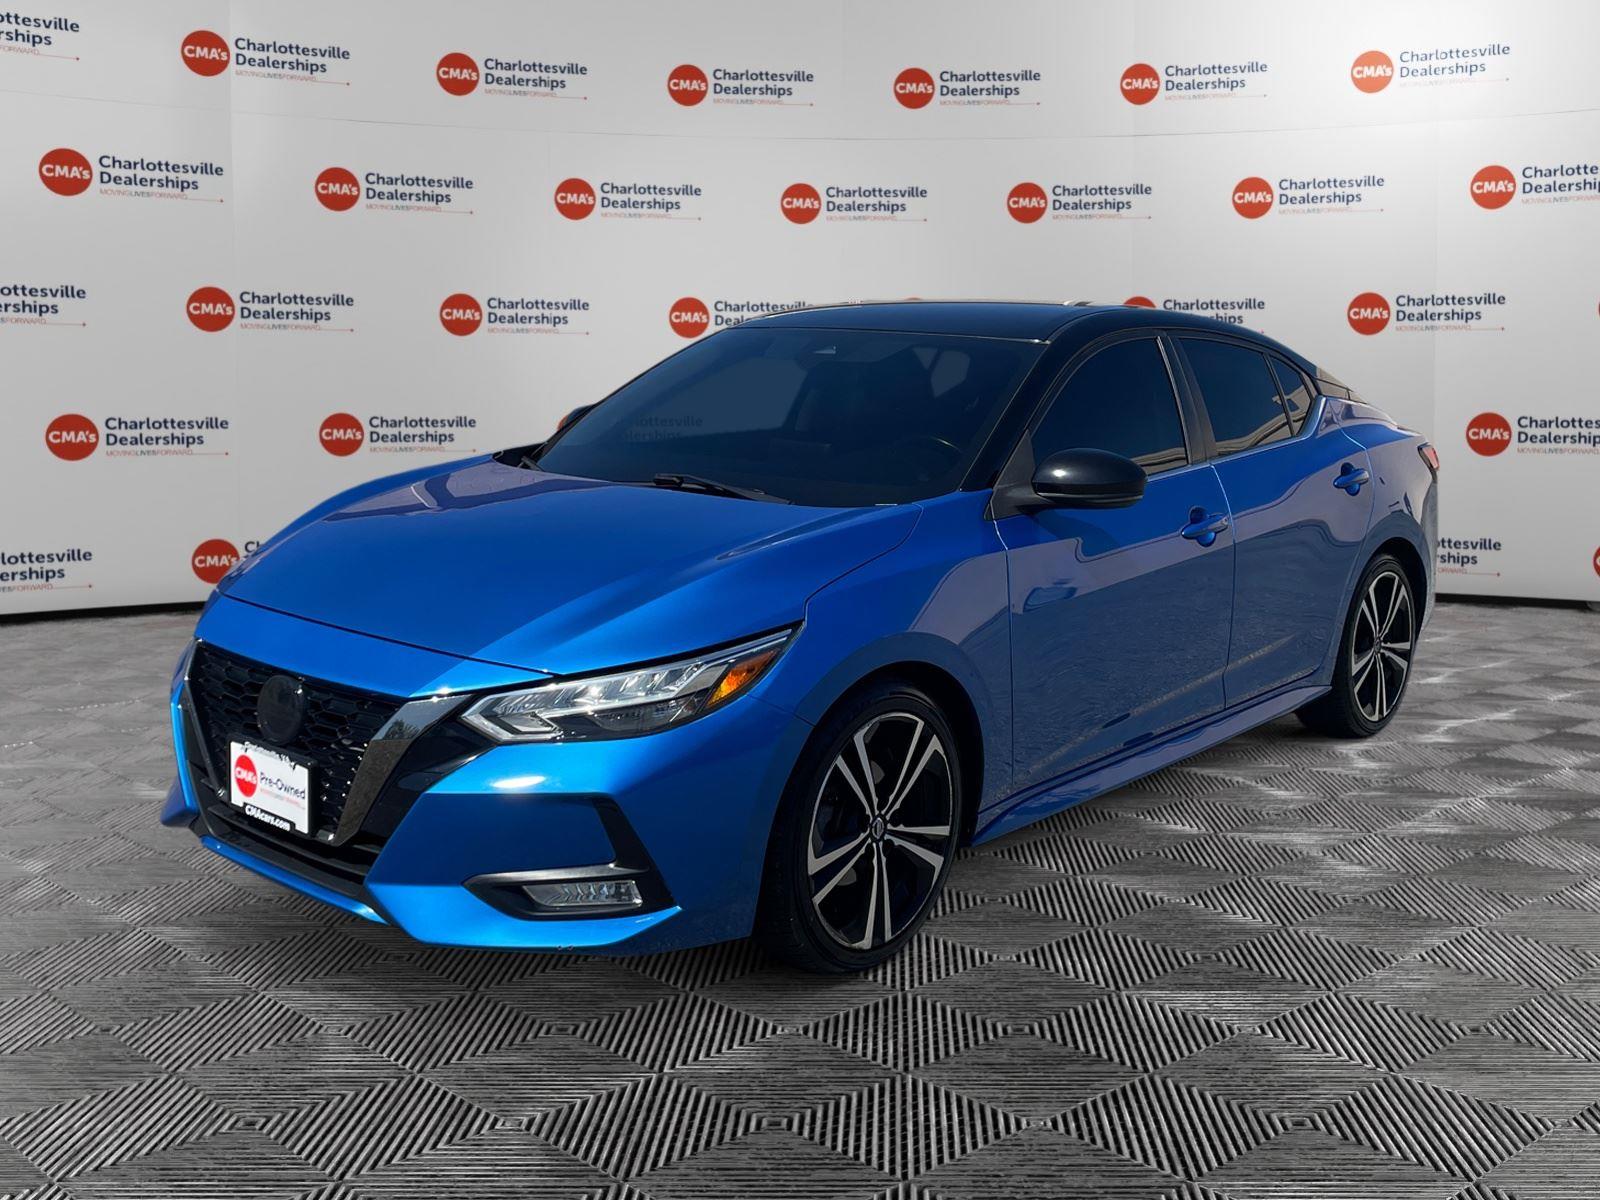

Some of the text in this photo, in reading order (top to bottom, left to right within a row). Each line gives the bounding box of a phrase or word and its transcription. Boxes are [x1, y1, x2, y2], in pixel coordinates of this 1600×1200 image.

[0, 11, 80, 33] ottesville
[183, 45, 229, 61] CMA's
[234, 37, 351, 60] Charlottesville
[1399, 43, 1511, 63] Charlottesville
[235, 52, 328, 76] Dealerships
[483, 57, 588, 76] Charlottesville
[1164, 61, 1268, 77] Charlottesville
[1352, 65, 1393, 79] CMA's
[1399, 62, 1486, 78] Dealerships
[439, 67, 477, 81] CMA's
[484, 72, 567, 92] Dealerships
[712, 68, 814, 83] Charlottesville
[939, 69, 1041, 83] Charlottesville
[670, 78, 706, 91] CMA's
[713, 82, 793, 99] Dealerships
[896, 82, 933, 94] CMA's
[939, 83, 1021, 99] Dealerships
[1121, 77, 1159, 90] CMA's
[1165, 77, 1246, 92] Dealerships
[41, 163, 91, 180] CMA's
[98, 154, 224, 177] Charlottesville
[1521, 163, 1600, 179] Charlotte
[99, 170, 199, 193] Dealerships
[317, 182, 358, 196] CMA's
[364, 172, 474, 190] Charlottesville
[599, 181, 702, 197] Charlottesville
[1278, 175, 1385, 191] Charlottesville
[1472, 180, 1515, 194] CMA's
[1521, 177, 1600, 195] Dealershi
[365, 186, 452, 206] Dealerships
[825, 186, 928, 199] Charlottesville
[1051, 183, 1153, 197] Charlottesville
[1233, 191, 1272, 204] CMA's
[556, 192, 593, 205] CMA's
[600, 196, 681, 213] Dealerships
[783, 197, 819, 209] CMA's
[1008, 196, 1046, 209] CMA's
[1052, 197, 1132, 213] Dealerships
[1278, 191, 1362, 206] Dealerships
[826, 200, 907, 215] Dealerships
[0, 284, 87, 300] ottesville
[239, 290, 355, 307] Charlottesville
[1395, 292, 1506, 308] Charlottesville
[0, 299, 59, 318] rships
[188, 302, 233, 316] CMA's
[486, 296, 590, 311] Charlottesville
[1162, 297, 1266, 311] Charlottesville
[240, 306, 332, 324] Dealerships
[442, 308, 480, 321] CMA's
[487, 311, 569, 328] Dealerships
[670, 311, 708, 324] CMA's
[1349, 307, 1389, 320] CMA's
[1395, 308, 1482, 324] Dealerships
[104, 416, 229, 431] Charlottesville
[368, 415, 477, 429] Charlottesville
[1517, 415, 1600, 430] Charlottes
[48, 430, 97, 444] CMA's
[105, 432, 205, 449] Dealerships
[321, 428, 362, 441] CMA's
[369, 430, 455, 446] Dealerships
[1468, 427, 1510, 441] CMA's
[1517, 430, 1600, 448] Dealership
[1436, 537, 1502, 552] ttesville
[0, 548, 93, 566] lottesville
[0, 566, 66, 583] erships
[260, 772, 305, 799] Pre-Owned
